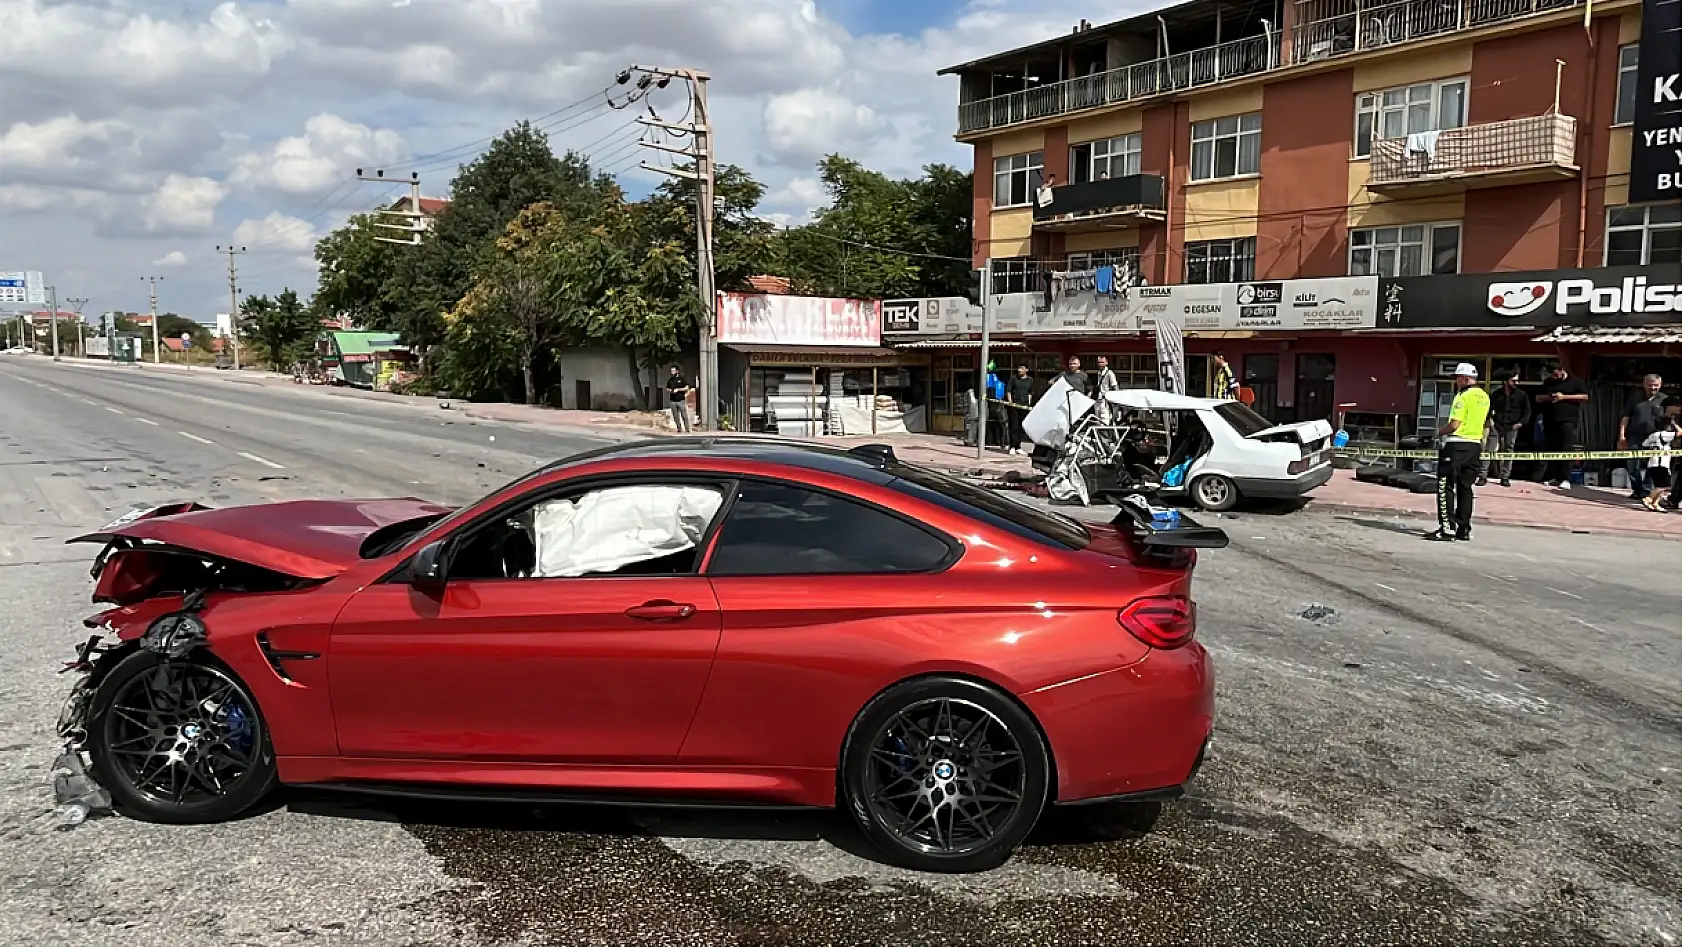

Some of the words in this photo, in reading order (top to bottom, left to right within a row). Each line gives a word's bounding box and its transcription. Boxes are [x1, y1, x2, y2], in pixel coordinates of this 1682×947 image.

[1654, 73, 1682, 103] K
[1556, 275, 1682, 315] Polis
[884, 305, 919, 323] TEK
